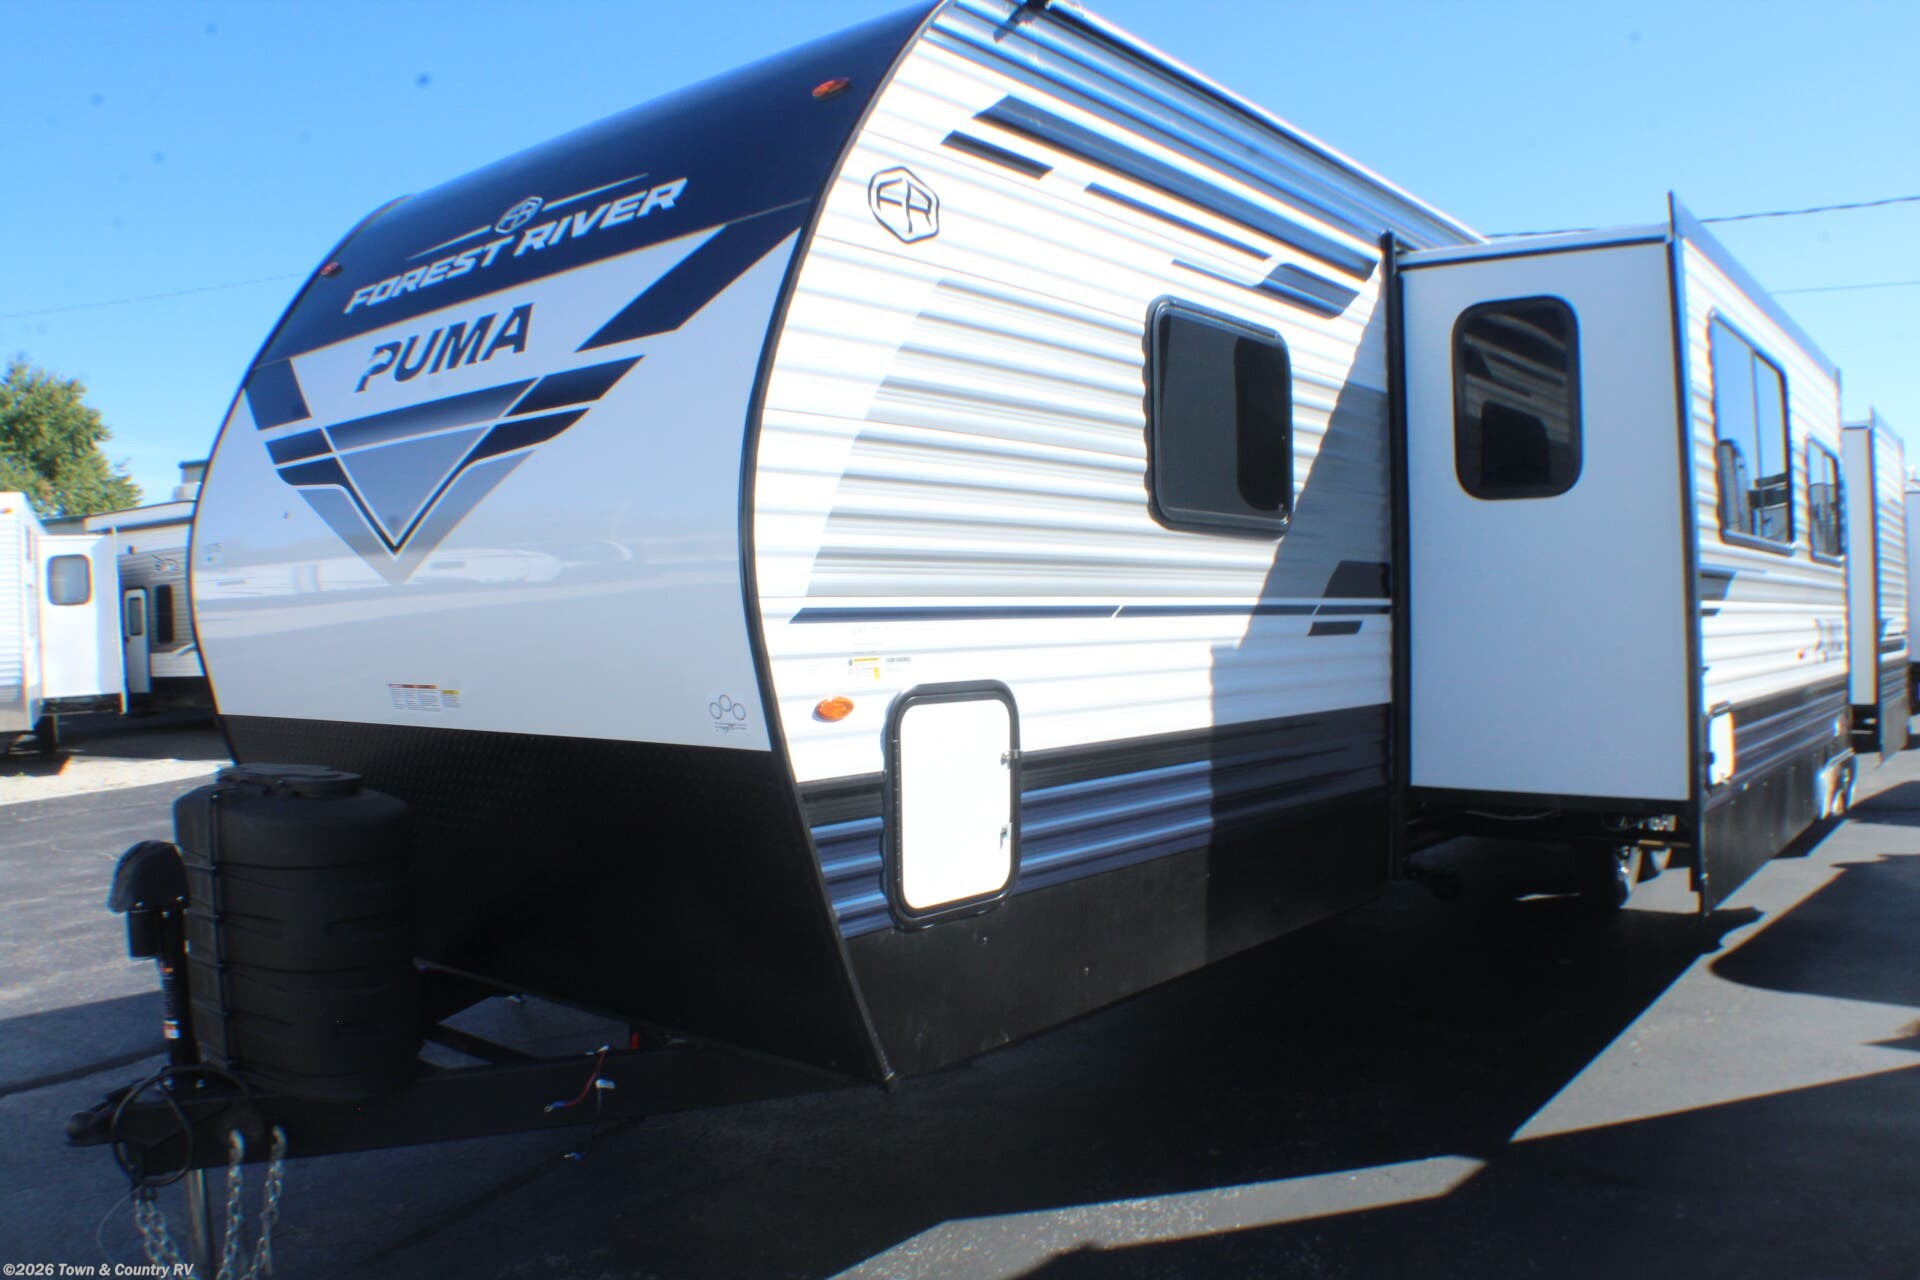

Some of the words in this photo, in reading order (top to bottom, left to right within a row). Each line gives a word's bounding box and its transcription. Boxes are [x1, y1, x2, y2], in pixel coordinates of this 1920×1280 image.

[344, 236, 515, 314] FOREST
[513, 177, 689, 256] RIVER
[354, 302, 534, 393] PUMA
